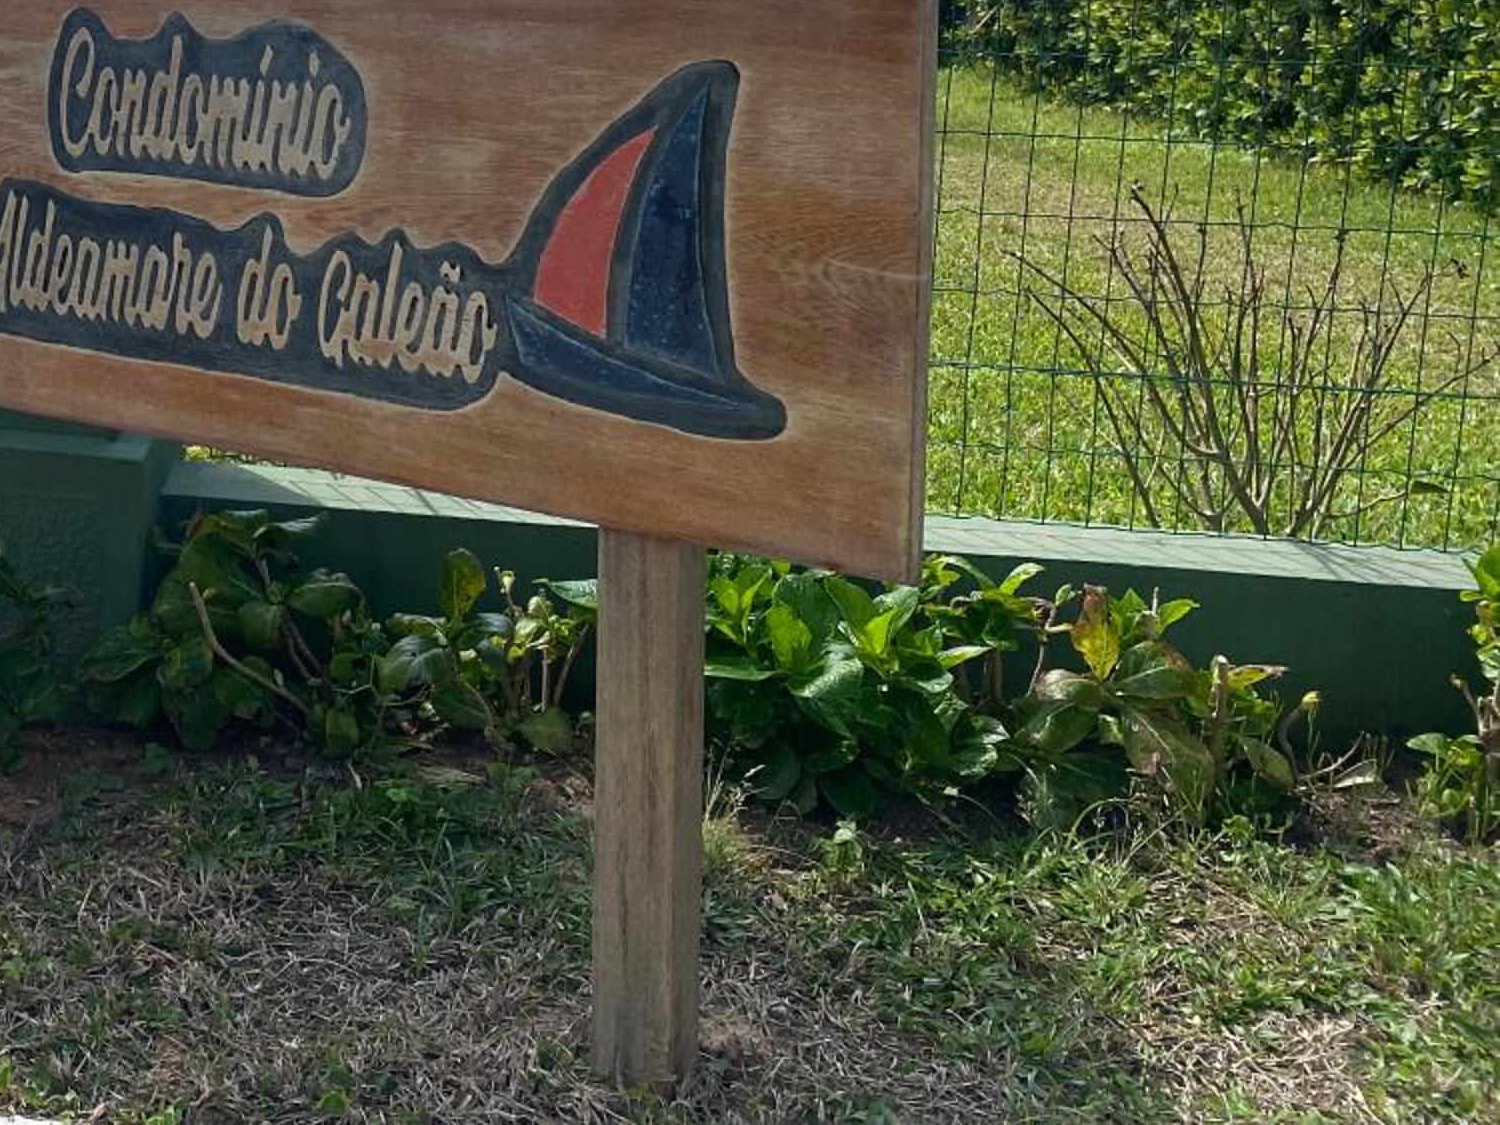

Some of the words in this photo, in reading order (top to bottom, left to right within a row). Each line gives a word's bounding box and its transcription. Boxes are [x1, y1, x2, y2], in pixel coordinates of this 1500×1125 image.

[57, 25, 350, 180] Condomínio
[236, 222, 301, 350] do
[318, 241, 497, 383] Galeão
